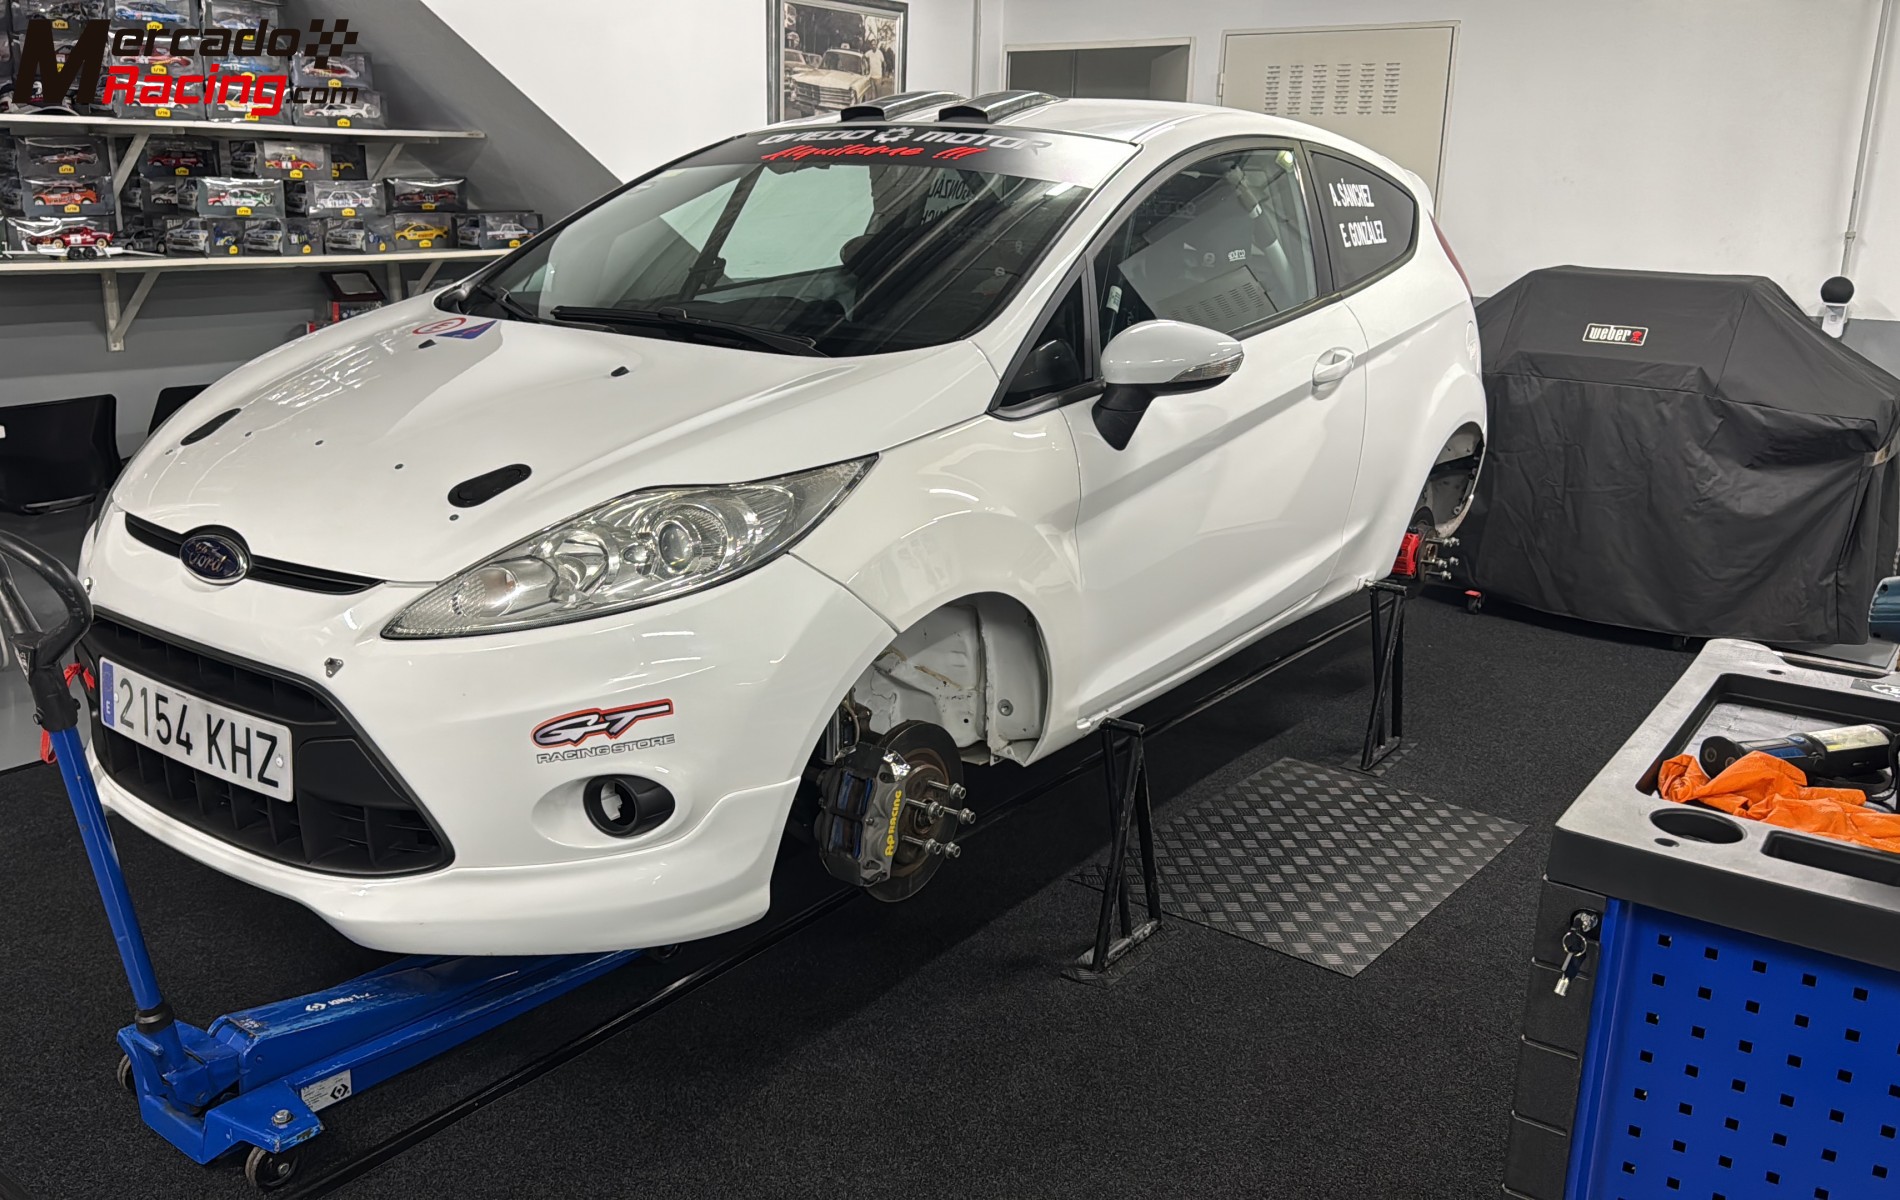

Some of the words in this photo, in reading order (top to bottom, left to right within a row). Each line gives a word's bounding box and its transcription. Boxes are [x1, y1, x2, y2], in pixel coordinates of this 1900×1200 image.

[913, 130, 1052, 156] MOTOR
[1337, 178, 1375, 207] SÁNCHEZ
[1348, 216, 1387, 247] GONZÁLEZ
[1589, 325, 1632, 342] weber
[119, 678, 193, 756] 2154
[207, 713, 279, 788] KHZ
[537, 745, 611, 764] RACING
[611, 734, 676, 754] STORE
